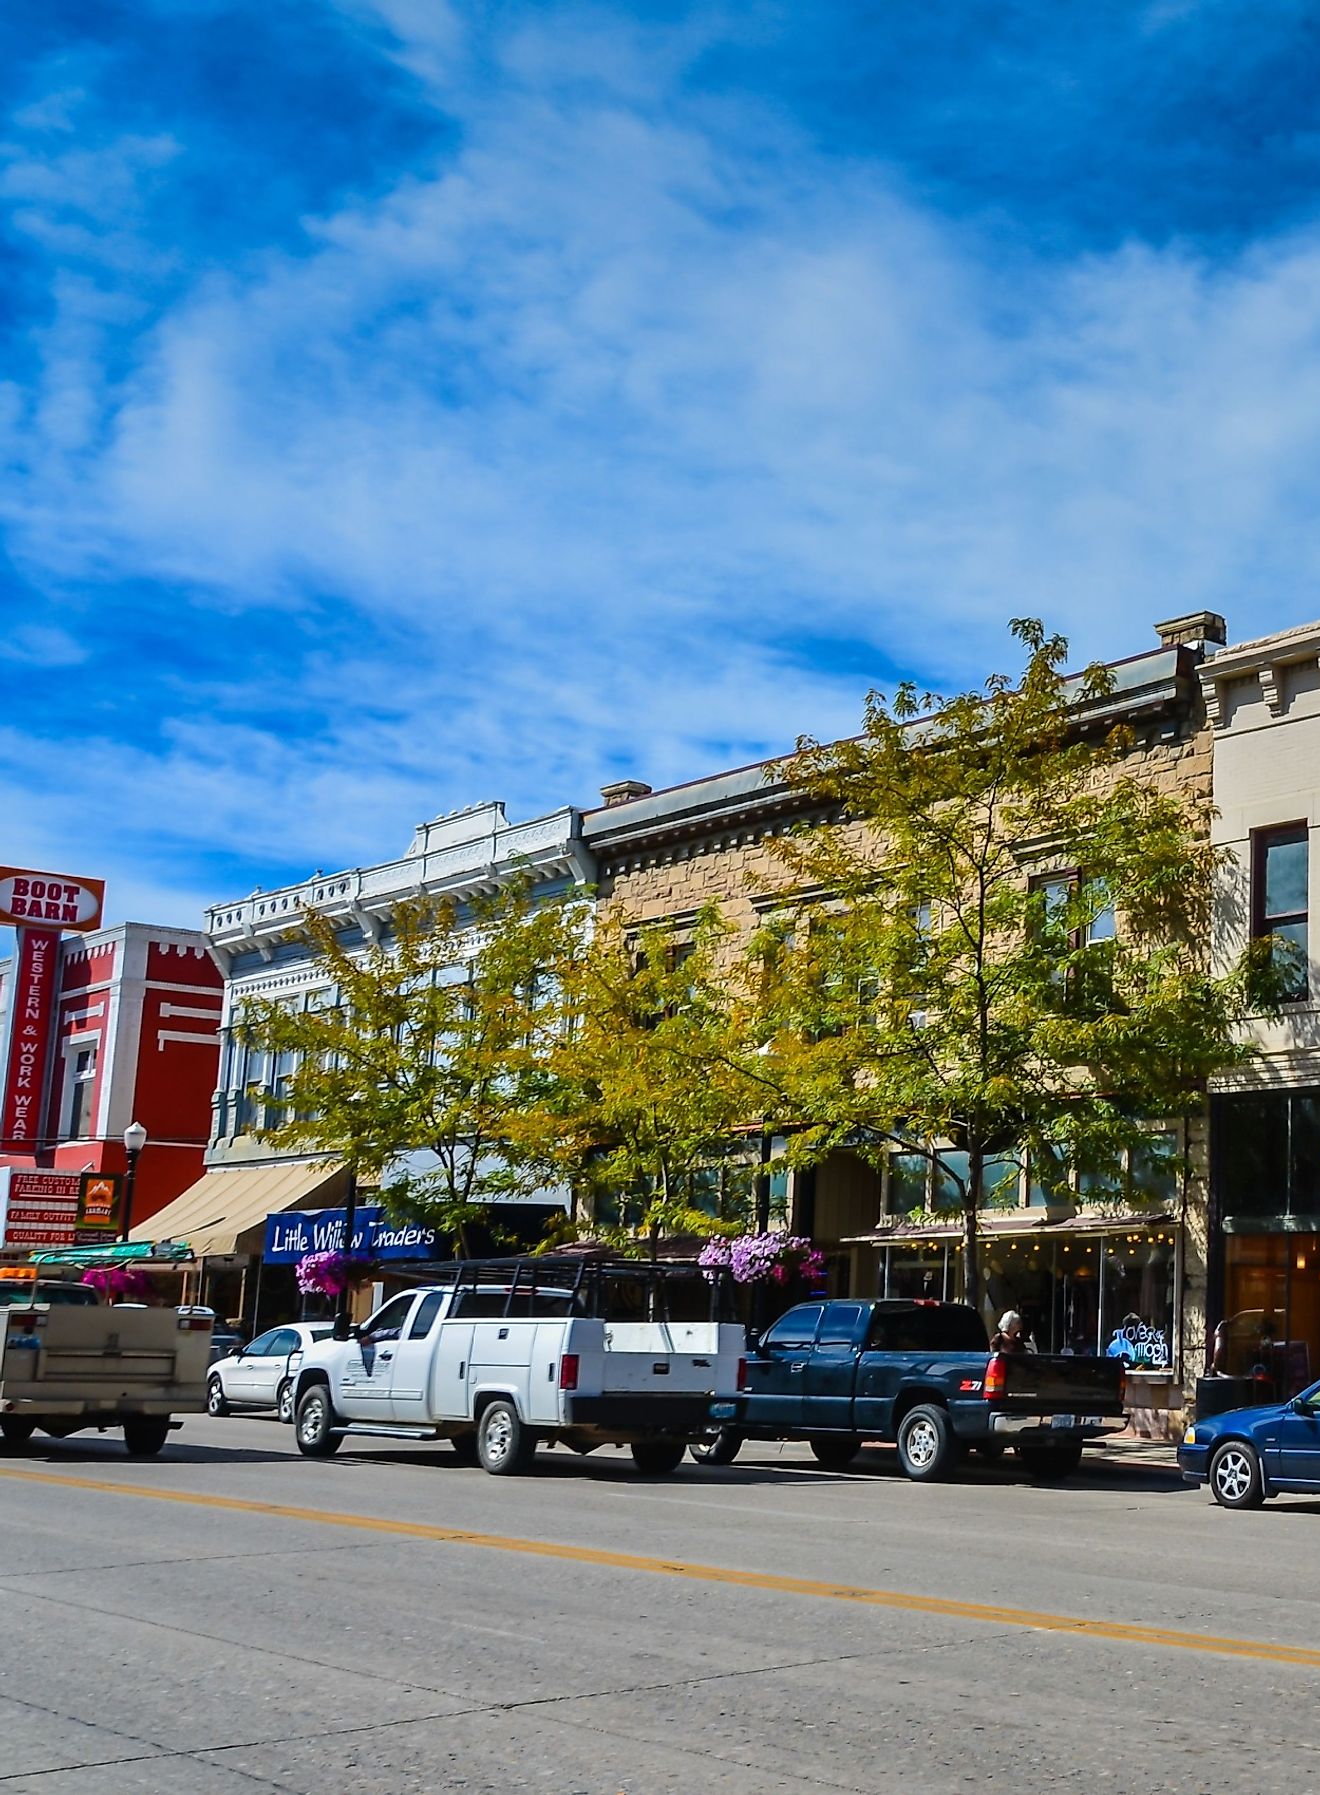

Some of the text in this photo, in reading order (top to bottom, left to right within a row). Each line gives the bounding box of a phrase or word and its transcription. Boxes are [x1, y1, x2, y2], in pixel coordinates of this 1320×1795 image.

[13, 878, 80, 903] BOOT
[11, 897, 78, 922] BARN
[12, 939, 49, 1140] WESTERN & WORK WEAR
[17, 1175, 39, 1184] FREE
[14, 1184, 54, 1194] PARKING
[10, 1211, 41, 1220] FAMILY
[12, 1231, 48, 1240] QUALITY
[271, 1222, 309, 1252] Little
[368, 1220, 435, 1248] Traders
[959, 1380, 982, 1391] Z71
